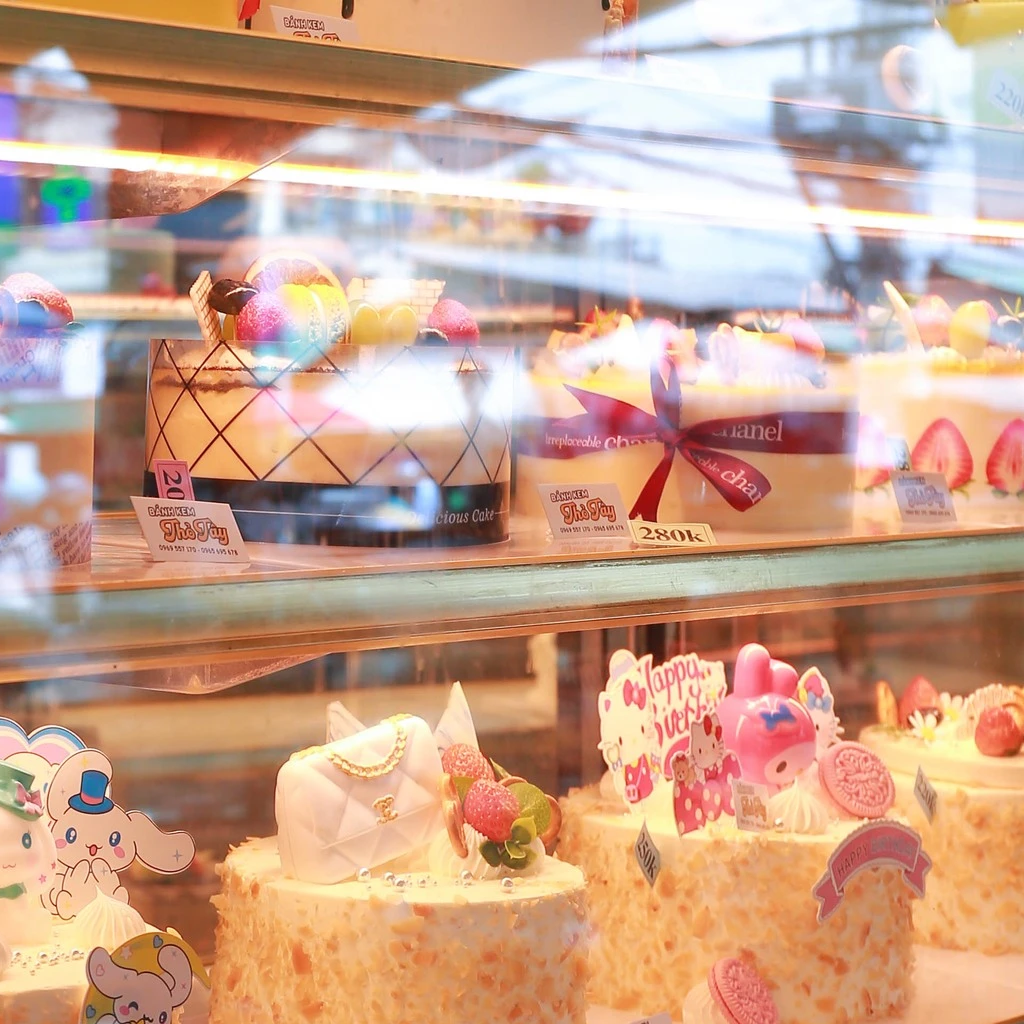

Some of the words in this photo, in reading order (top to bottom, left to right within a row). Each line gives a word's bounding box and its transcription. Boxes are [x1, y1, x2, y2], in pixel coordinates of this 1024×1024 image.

[573, 489, 590, 500] KEM
[176, 507, 196, 517] KEM
[472, 507, 495, 522] Cake
[560, 502, 590, 525] Thỏ
[587, 498, 617, 522] Tây
[160, 518, 196, 543] Thỏ
[193, 517, 229, 546] Tây
[638, 526, 705, 543] 280k
[837, 843, 868, 878] HAPPY
